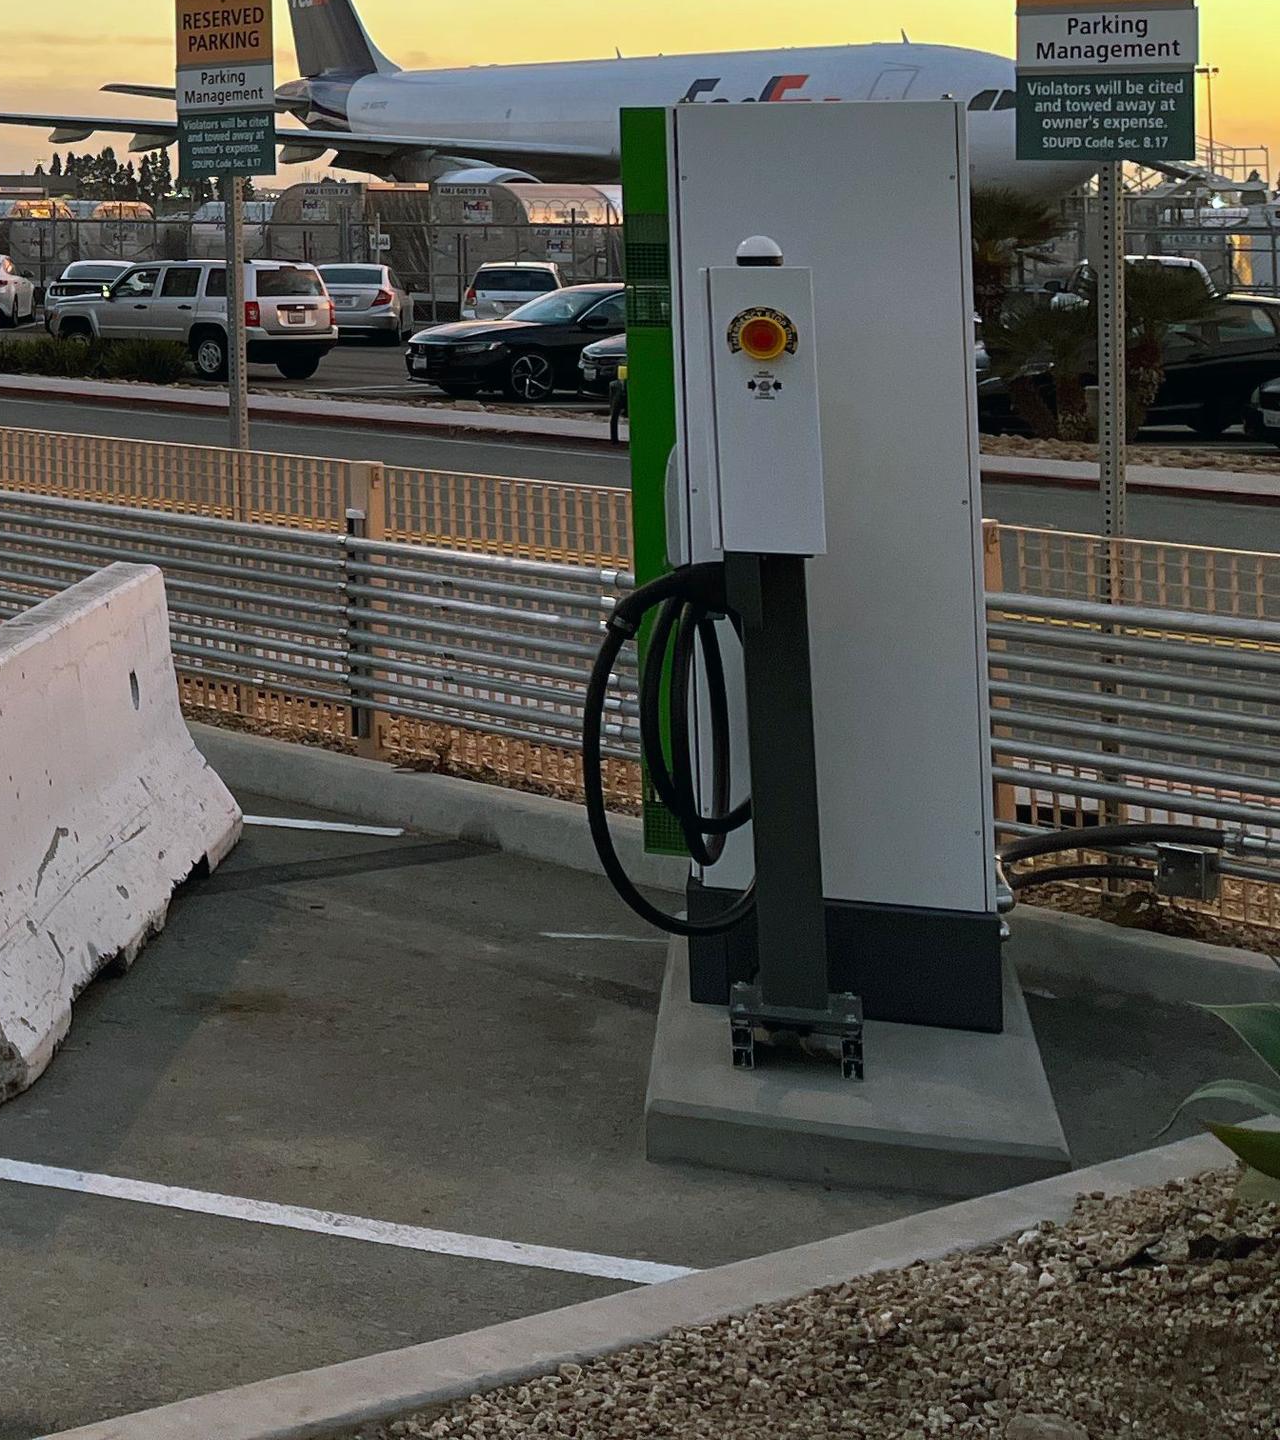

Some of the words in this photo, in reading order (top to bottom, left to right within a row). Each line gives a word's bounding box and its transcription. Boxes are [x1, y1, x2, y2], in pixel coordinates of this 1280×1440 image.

[182, 7, 264, 30] RESERVED
[1067, 15, 1148, 38] Parking
[188, 30, 260, 52] PARKING
[1035, 39, 1181, 63] Management
[200, 69, 246, 86] Parking
[184, 87, 264, 105] Management
[1027, 81, 1091, 96] Violators
[1096, 80, 1122, 95] will
[1126, 79, 1144, 94] be
[1148, 78, 1184, 94] cited
[1035, 98, 1061, 112] and
[1066, 97, 1112, 112] towed
[1116, 100, 1156, 114] away
[1160, 98, 1176, 111] at
[183, 119, 219, 130] Violators
[237, 117, 248, 128] be
[249, 116, 269, 128] cited
[1042, 115, 1100, 129] owner's
[1103, 117, 1168, 132] expense.
[1085, 136, 1114, 149] Code
